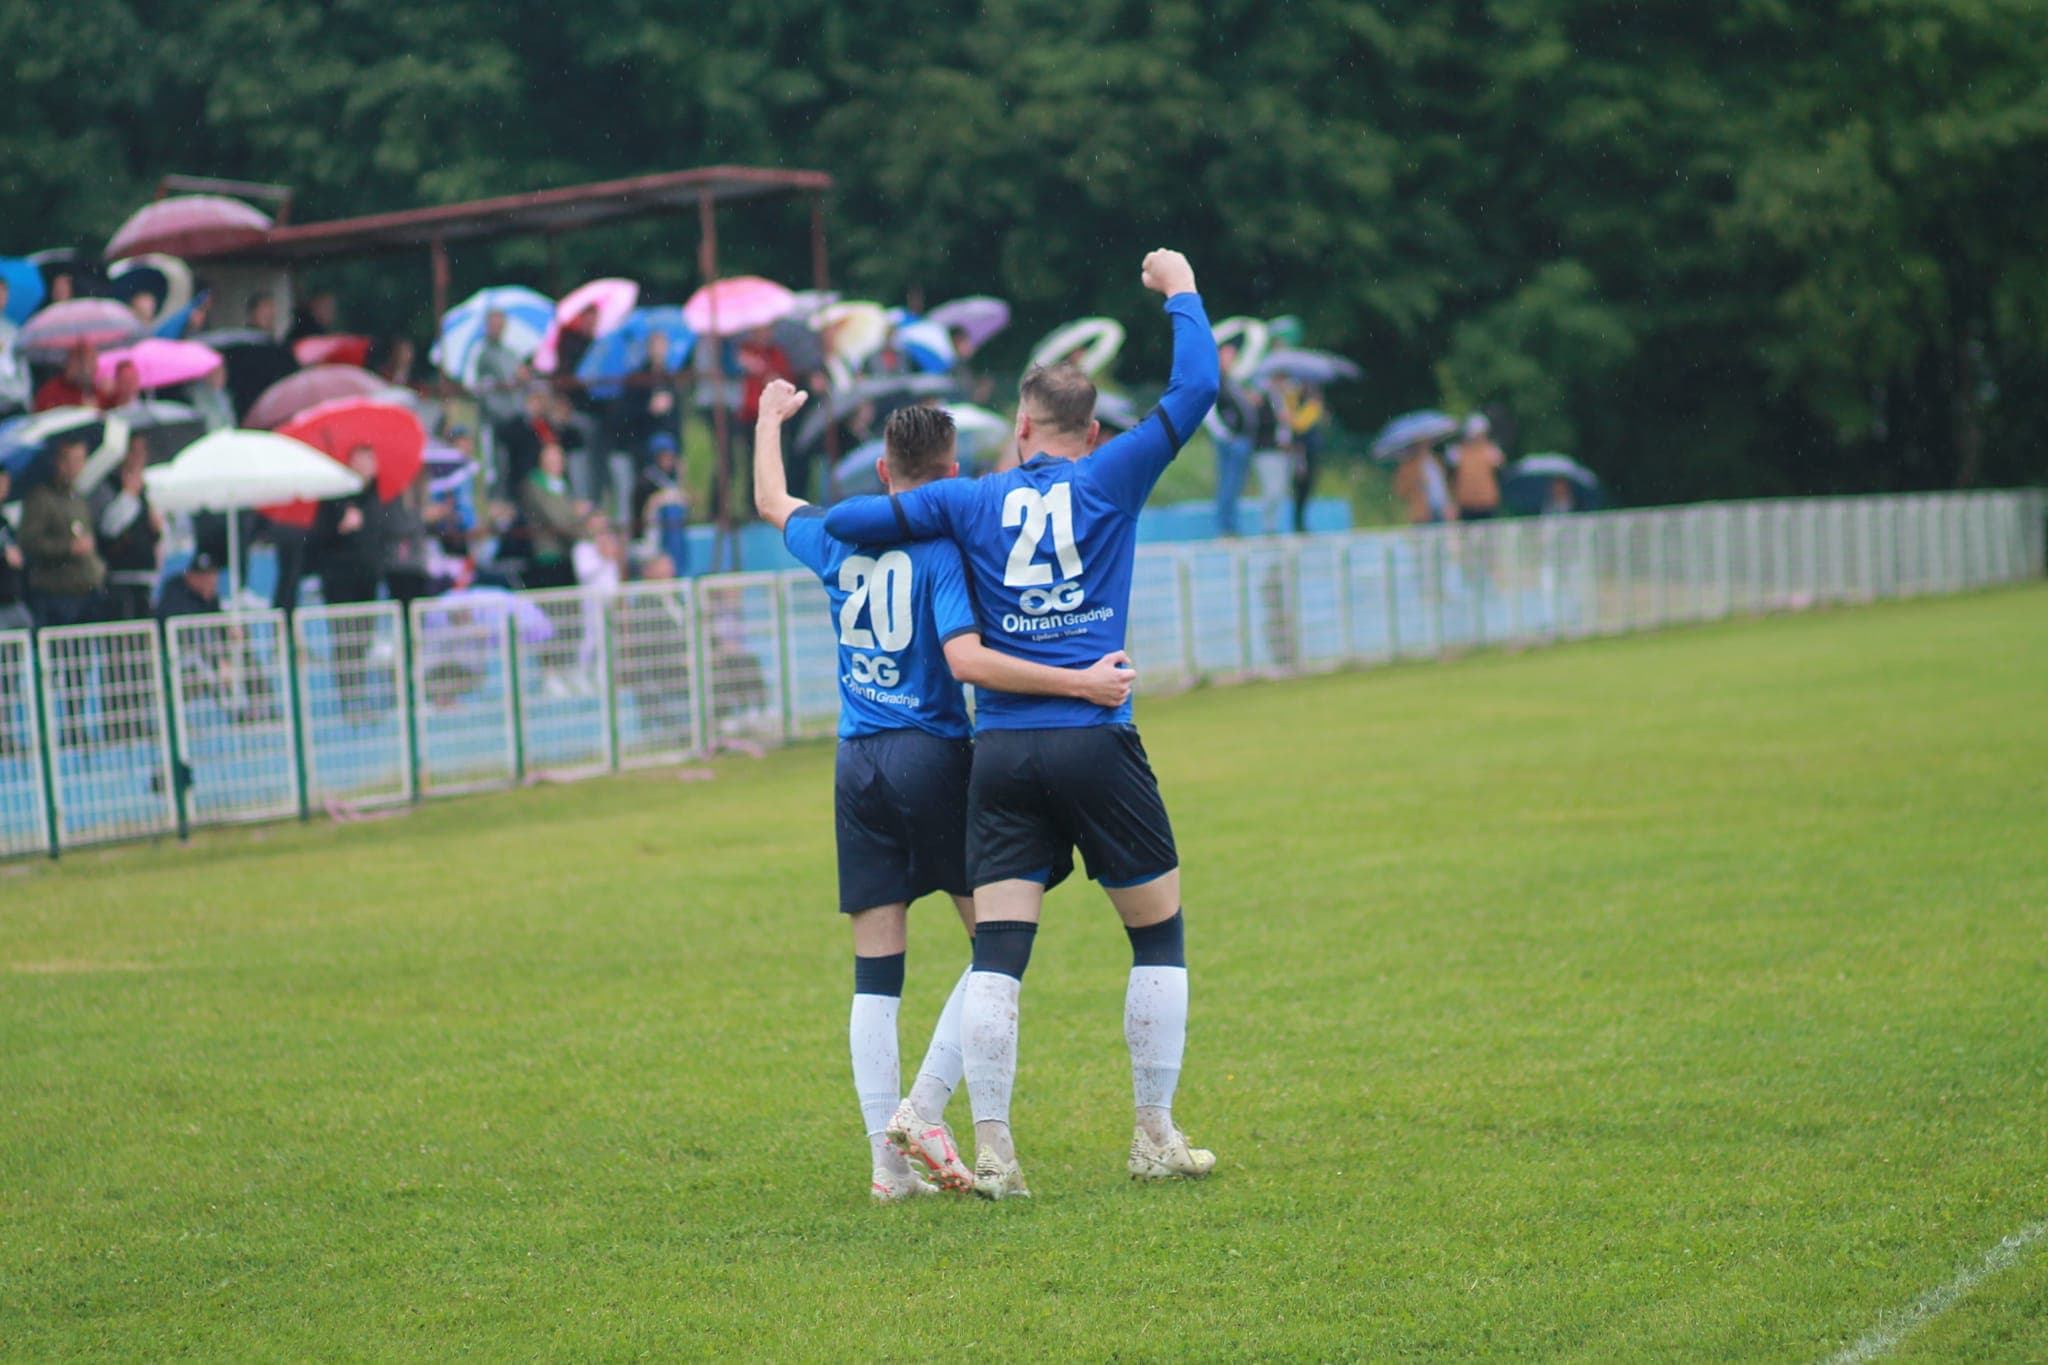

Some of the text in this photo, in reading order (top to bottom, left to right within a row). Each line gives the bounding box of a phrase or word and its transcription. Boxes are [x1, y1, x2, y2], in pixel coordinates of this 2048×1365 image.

[1003, 482, 1083, 586] 21
[838, 551, 913, 652] 20
[1019, 581, 1085, 615] OG
[1002, 606, 1114, 633] Ohran Gradnja
[876, 691, 920, 709] Gradnja
